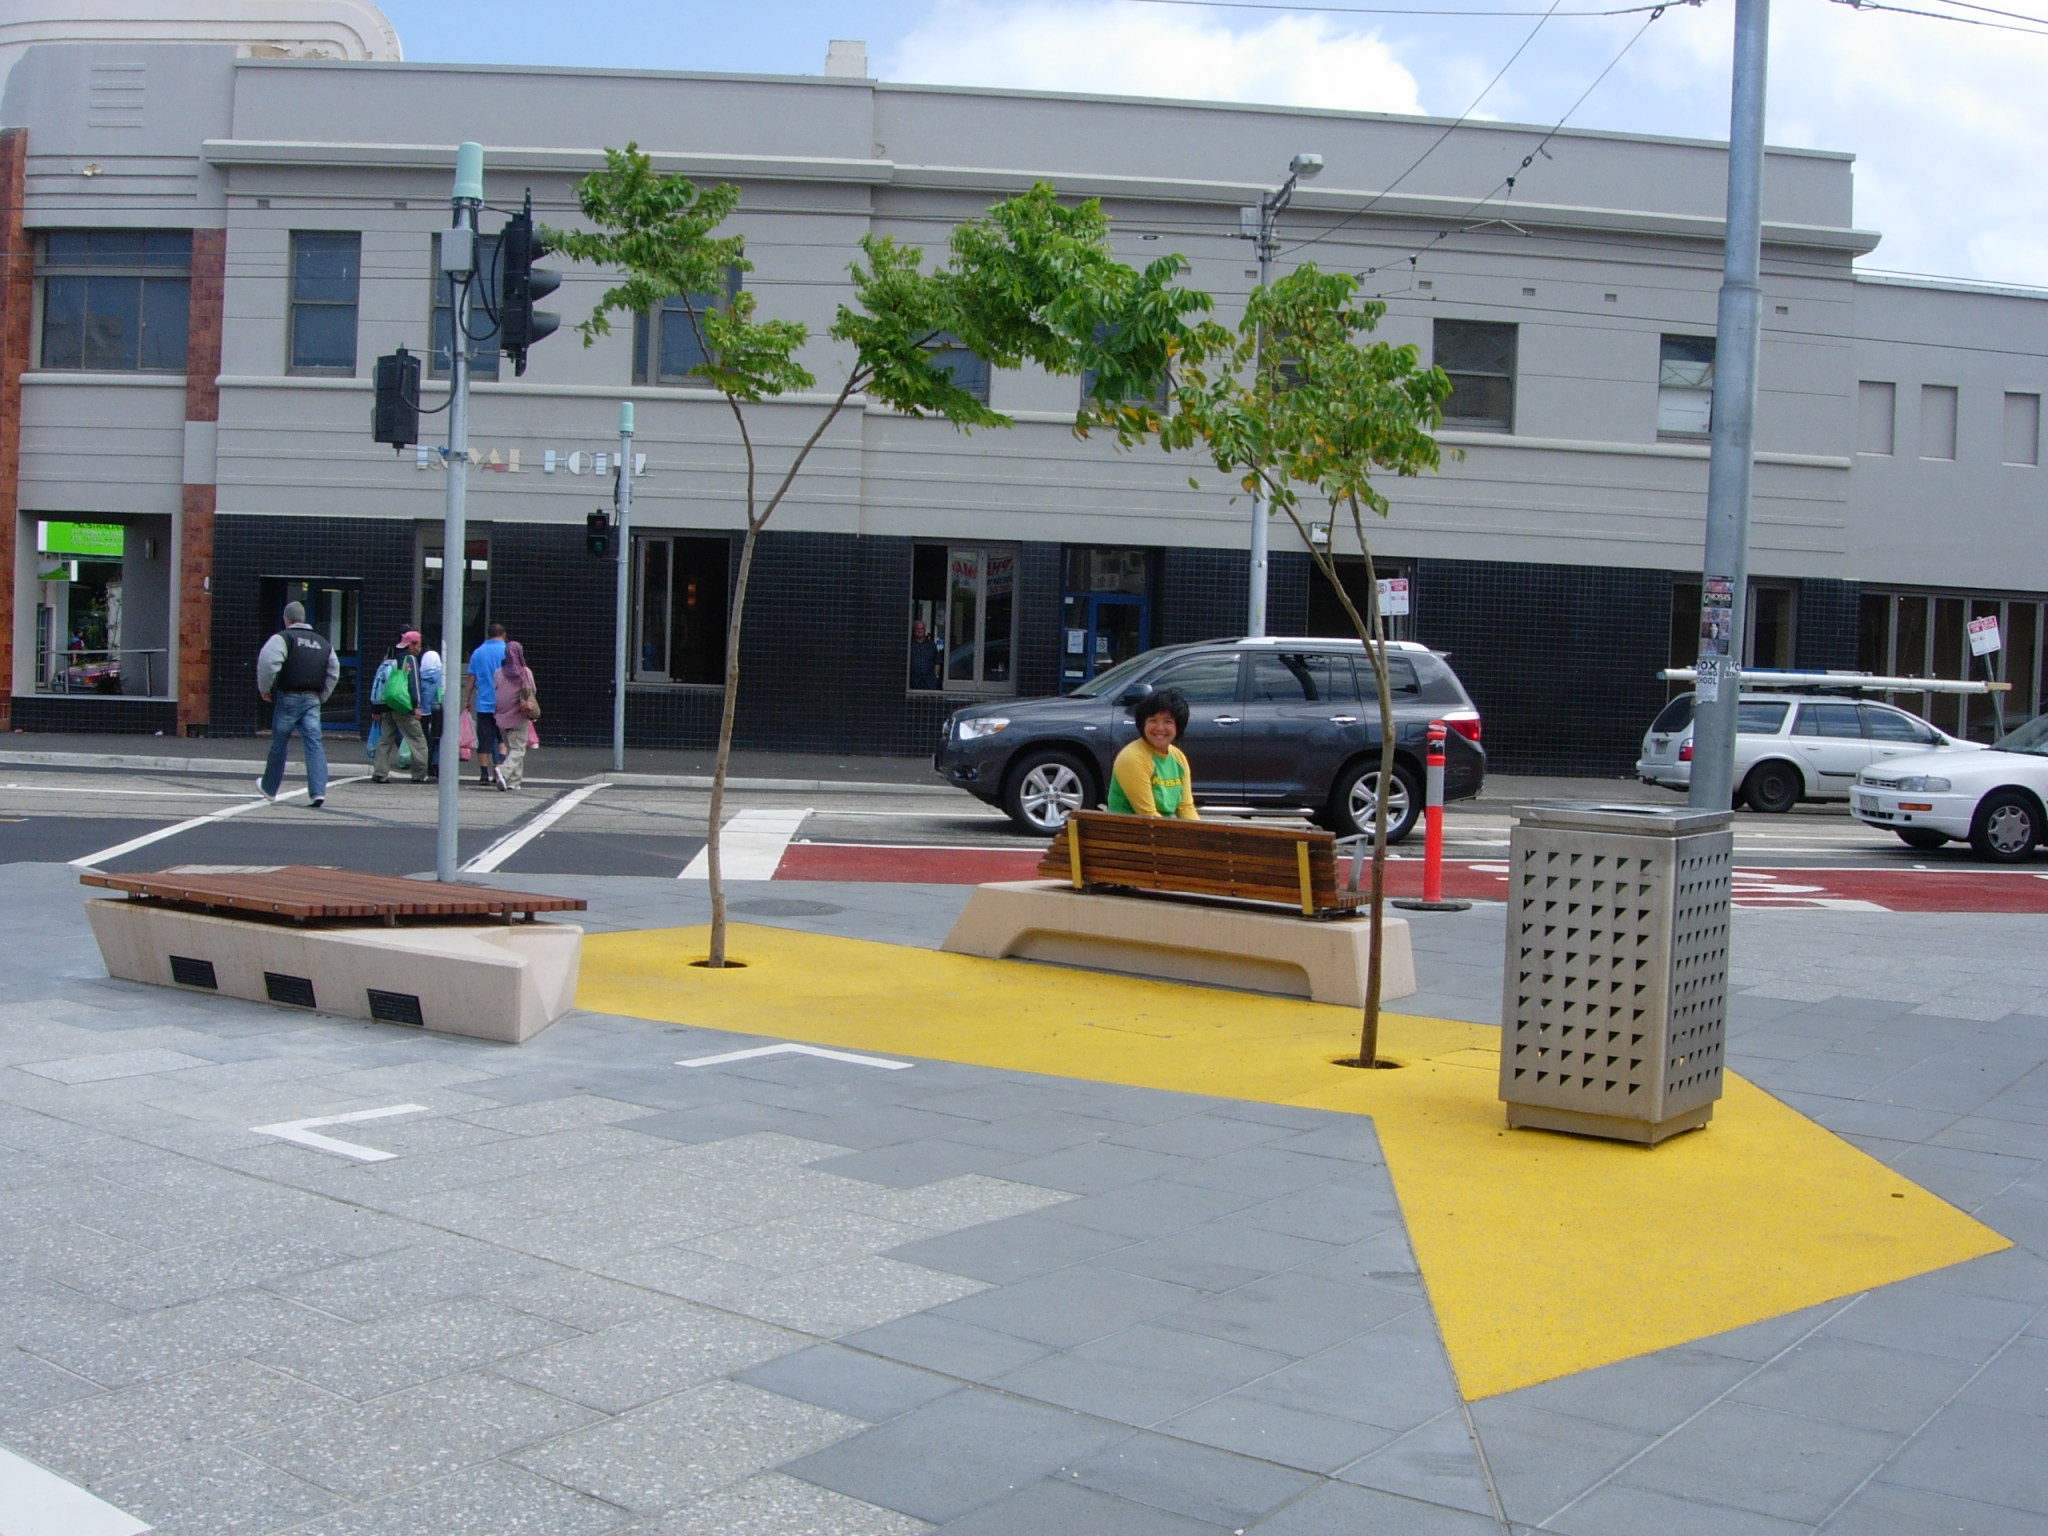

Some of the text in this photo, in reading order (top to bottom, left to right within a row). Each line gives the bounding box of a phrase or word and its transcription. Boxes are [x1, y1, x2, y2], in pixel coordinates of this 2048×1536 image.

[416, 446, 529, 473] RYAL
[297, 637, 322, 650] FILA
[1697, 660, 1718, 670] OX
